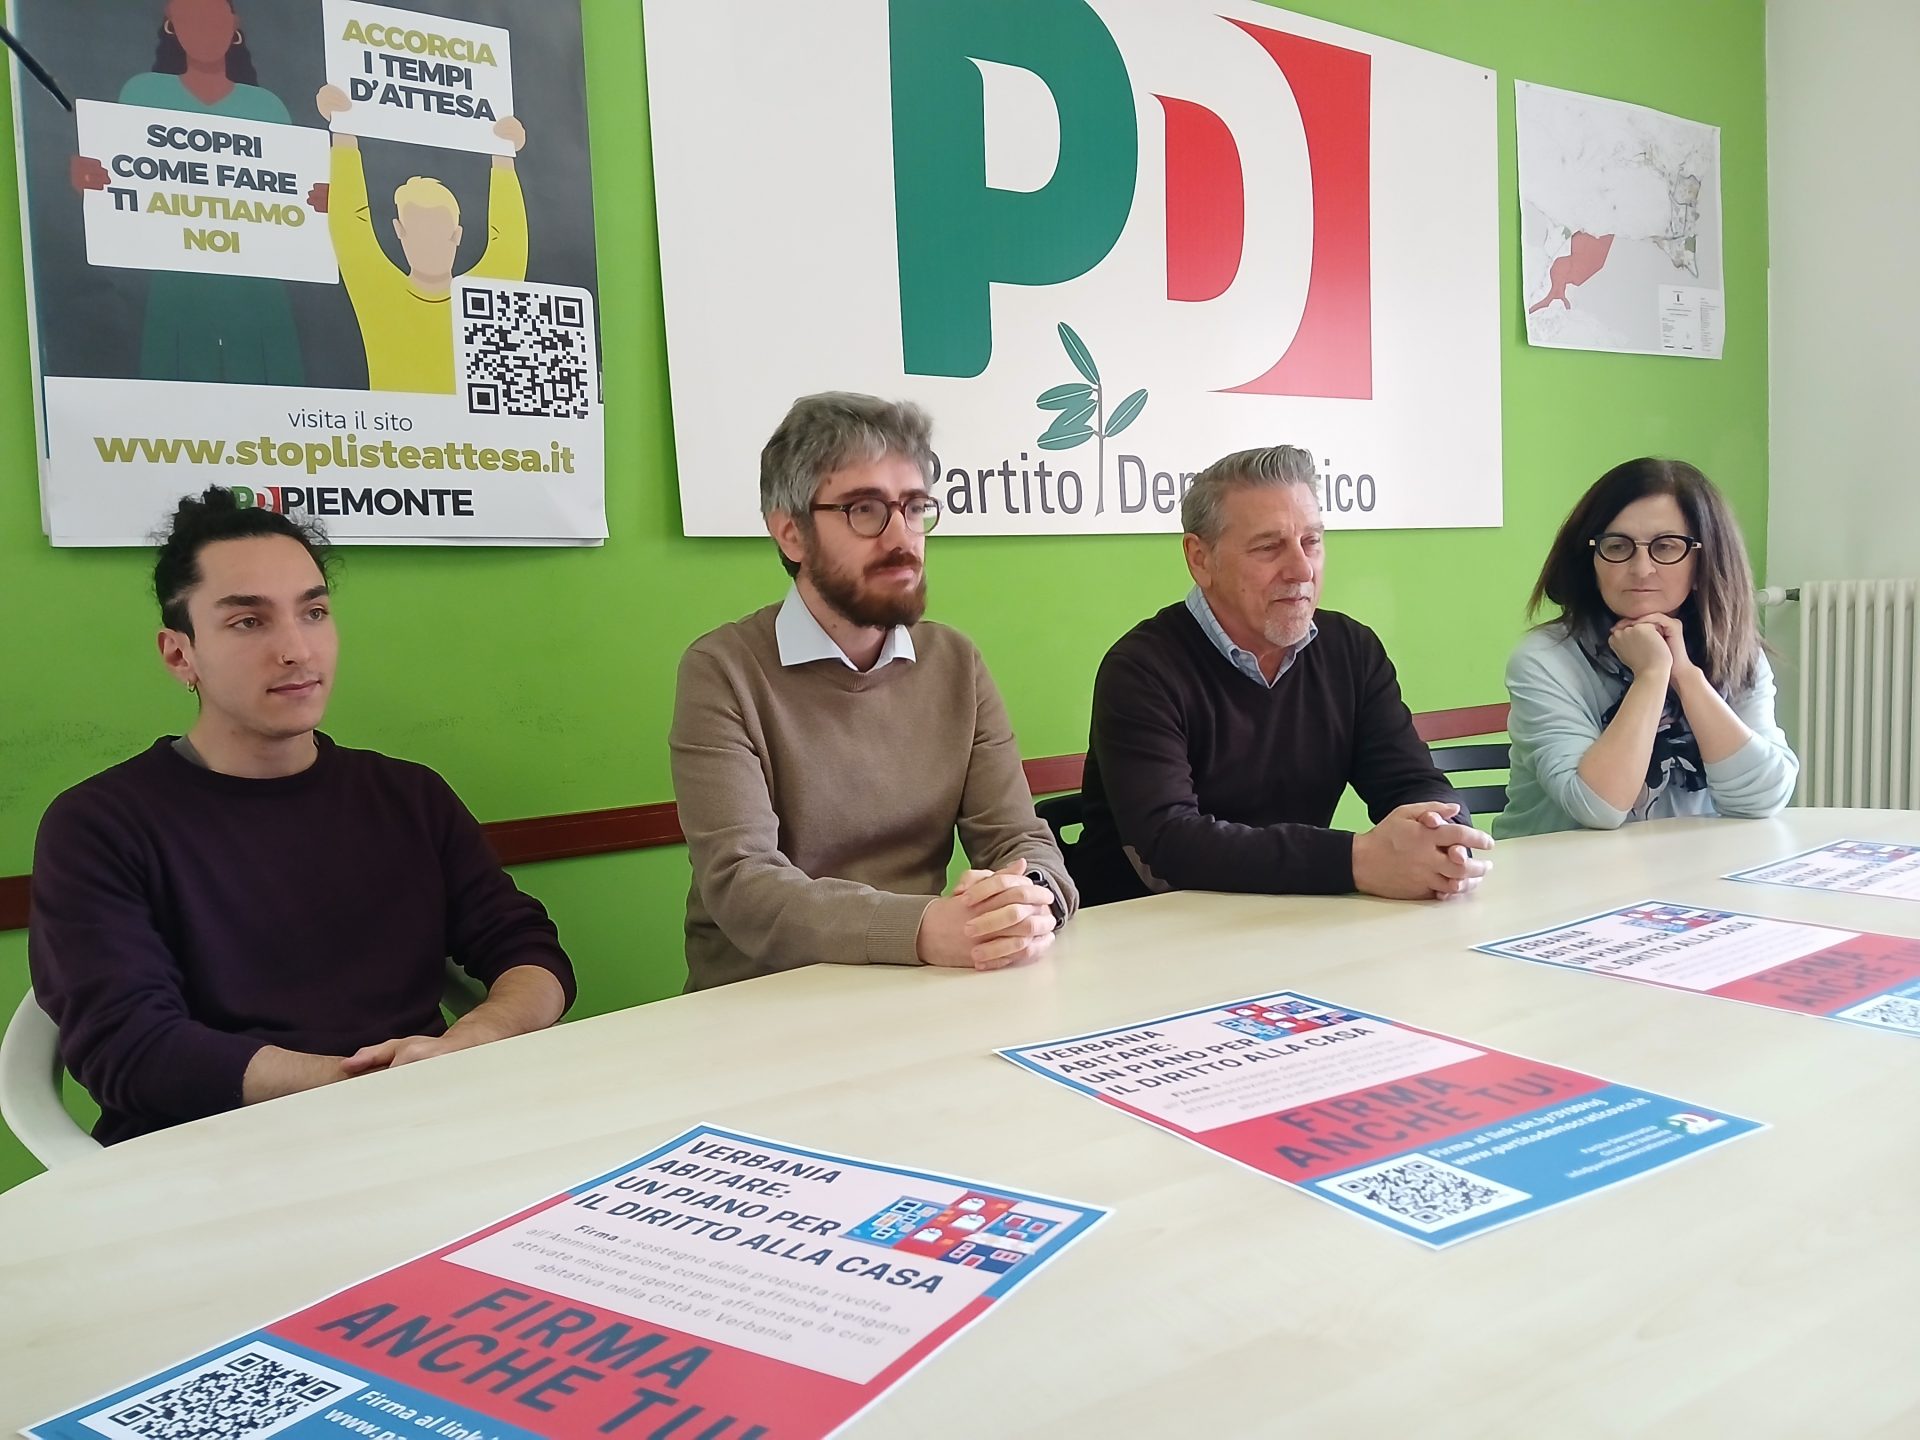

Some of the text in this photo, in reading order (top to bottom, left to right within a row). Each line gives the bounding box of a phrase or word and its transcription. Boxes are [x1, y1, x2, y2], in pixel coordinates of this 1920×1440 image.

[342, 19, 497, 67] ACCORCIA
[364, 51, 472, 91] I TEMPI
[350, 77, 496, 122] D'ATTESA
[147, 124, 262, 158] SCOPRI
[112, 154, 298, 195] COME FARE
[107, 187, 305, 227] TI AIUTIAMO
[183, 228, 240, 253] NOI
[288, 409, 414, 432] visita il sito
[93, 434, 575, 475] www.stoplisteattesa.it
[281, 487, 475, 517] PIEMONTE
[1503, 929, 1590, 953] VERBANIA
[1592, 938, 1646, 959] PIANO
[1674, 931, 1715, 949] ALLA
[1032, 1031, 1164, 1061] VERBANIA
[1058, 1043, 1178, 1073] ABITARE:
[1080, 1038, 1261, 1084] UN PIANO PER
[1105, 1084, 1140, 1095] IL
[1135, 1057, 1243, 1088] DIRITTO
[1249, 1040, 1309, 1063] ALLA
[1304, 1027, 1375, 1047] CASA
[1274, 1100, 1483, 1169] ANCHE
[1466, 1072, 1575, 1105] TU!
[1276, 1076, 1465, 1133] FIRMA
[648, 1160, 792, 1198] ABITARE:
[688, 1141, 842, 1184] VERBANIA
[614, 1176, 842, 1237] UN PIANO PER
[573, 1193, 944, 1294] IL DIRITTO ALLA CASA
[526, 1228, 911, 1335] all'Amministrazione comunale affinché vengano
[574, 1225, 893, 1313] Firma a sostegno della proposta rivolta
[512, 1240, 886, 1347] attivate misure urgenti per affrontare la crisi
[534, 1263, 793, 1343] abitativa nella Città di Verbania.
[315, 1302, 606, 1412] ANCHE
[450, 1287, 712, 1390] FIRMA
[356, 1391, 483, 1440] Firma al link
